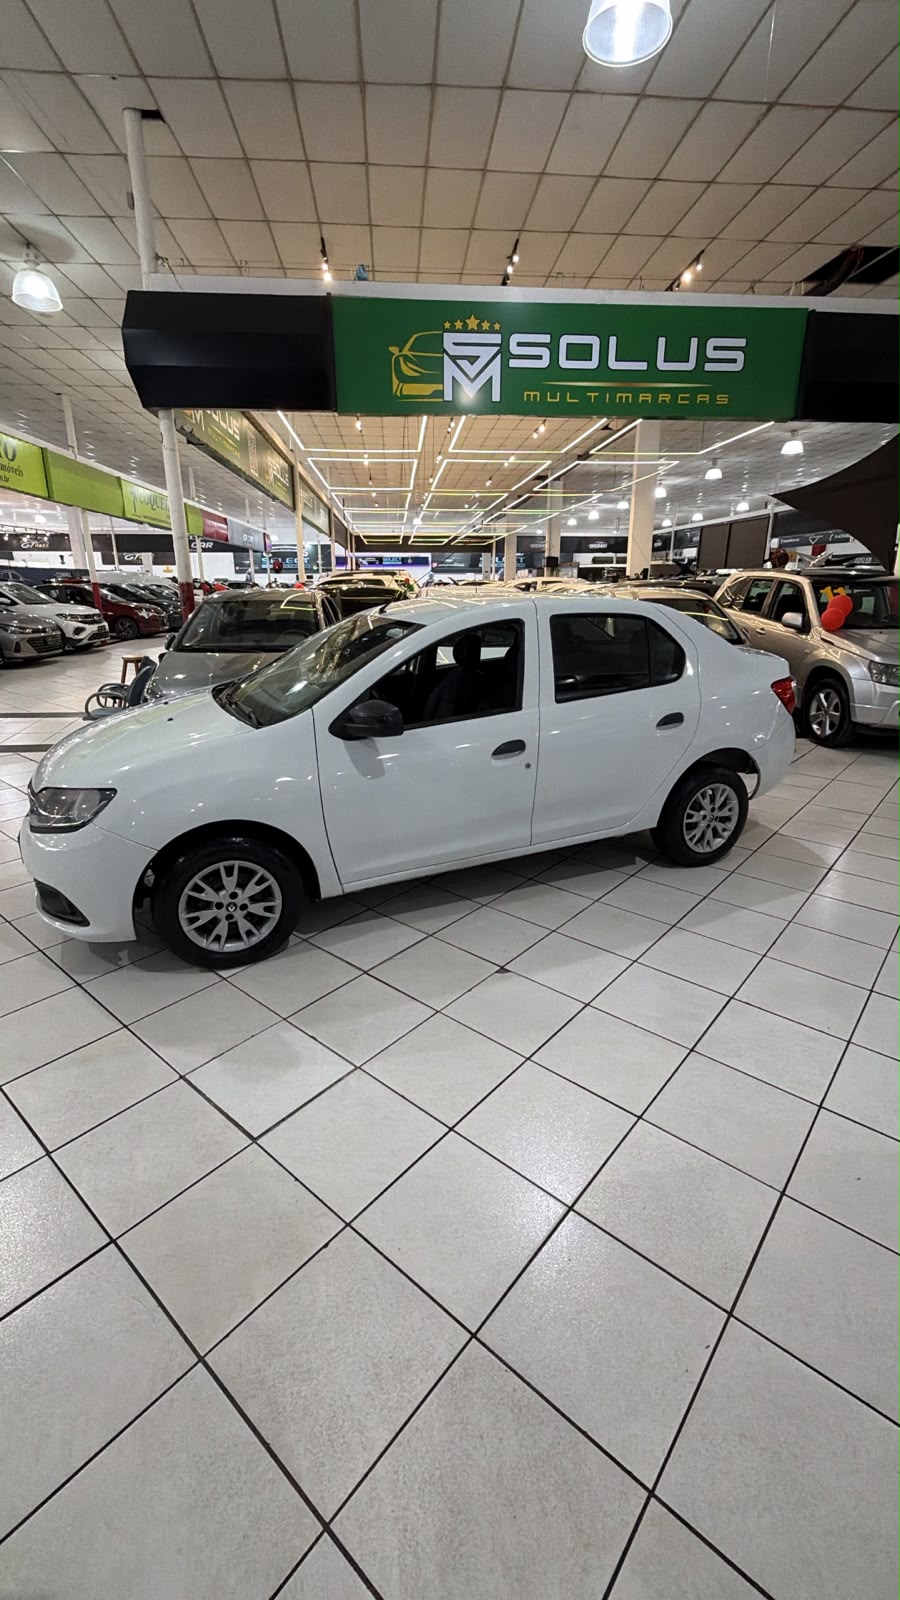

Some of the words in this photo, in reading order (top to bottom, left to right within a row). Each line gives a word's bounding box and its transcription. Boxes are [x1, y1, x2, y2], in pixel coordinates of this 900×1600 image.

[508, 333, 747, 372] SOLUS
[524, 391, 729, 405] MULTIMARCAS
[206, 410, 240, 441] OLUS
